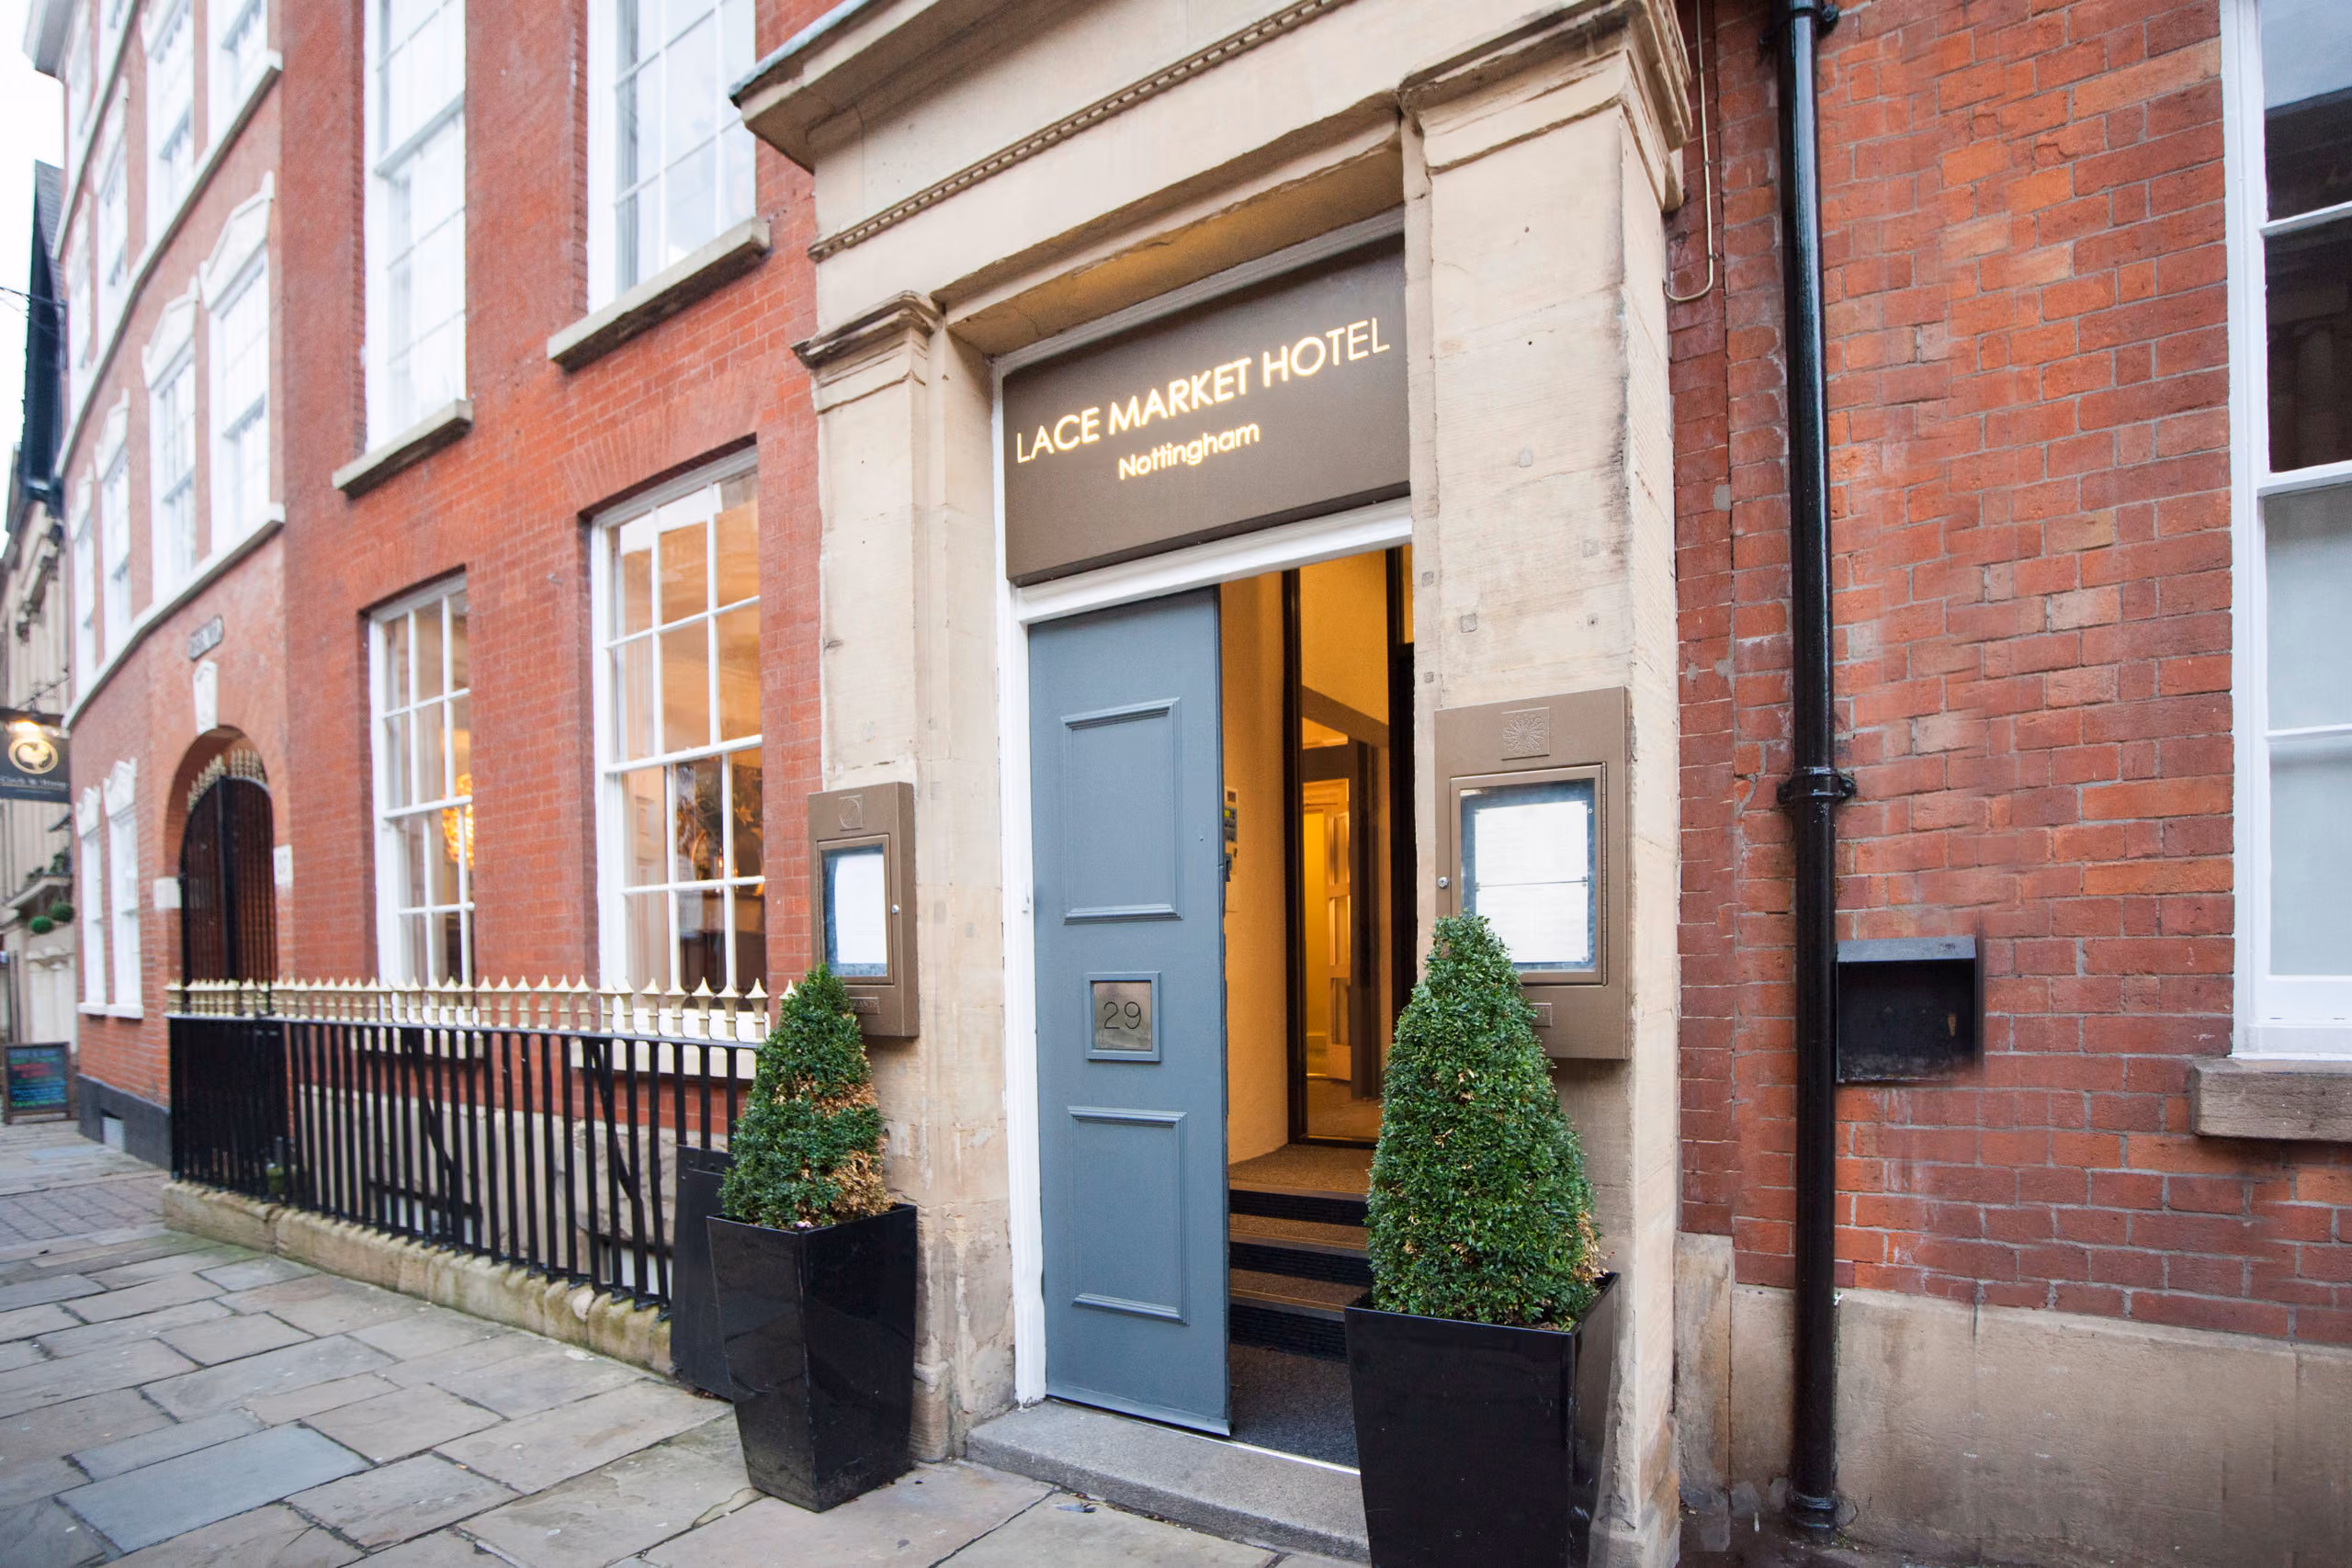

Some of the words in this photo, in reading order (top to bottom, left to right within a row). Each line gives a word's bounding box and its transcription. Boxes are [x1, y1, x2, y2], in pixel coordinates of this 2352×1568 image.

[1016, 406, 1101, 464] LACE
[1108, 357, 1252, 435] MARKET
[1261, 316, 1391, 388] HOTEL
[1118, 423, 1261, 480] Nottingham
[1103, 1001, 1142, 1030] 29
